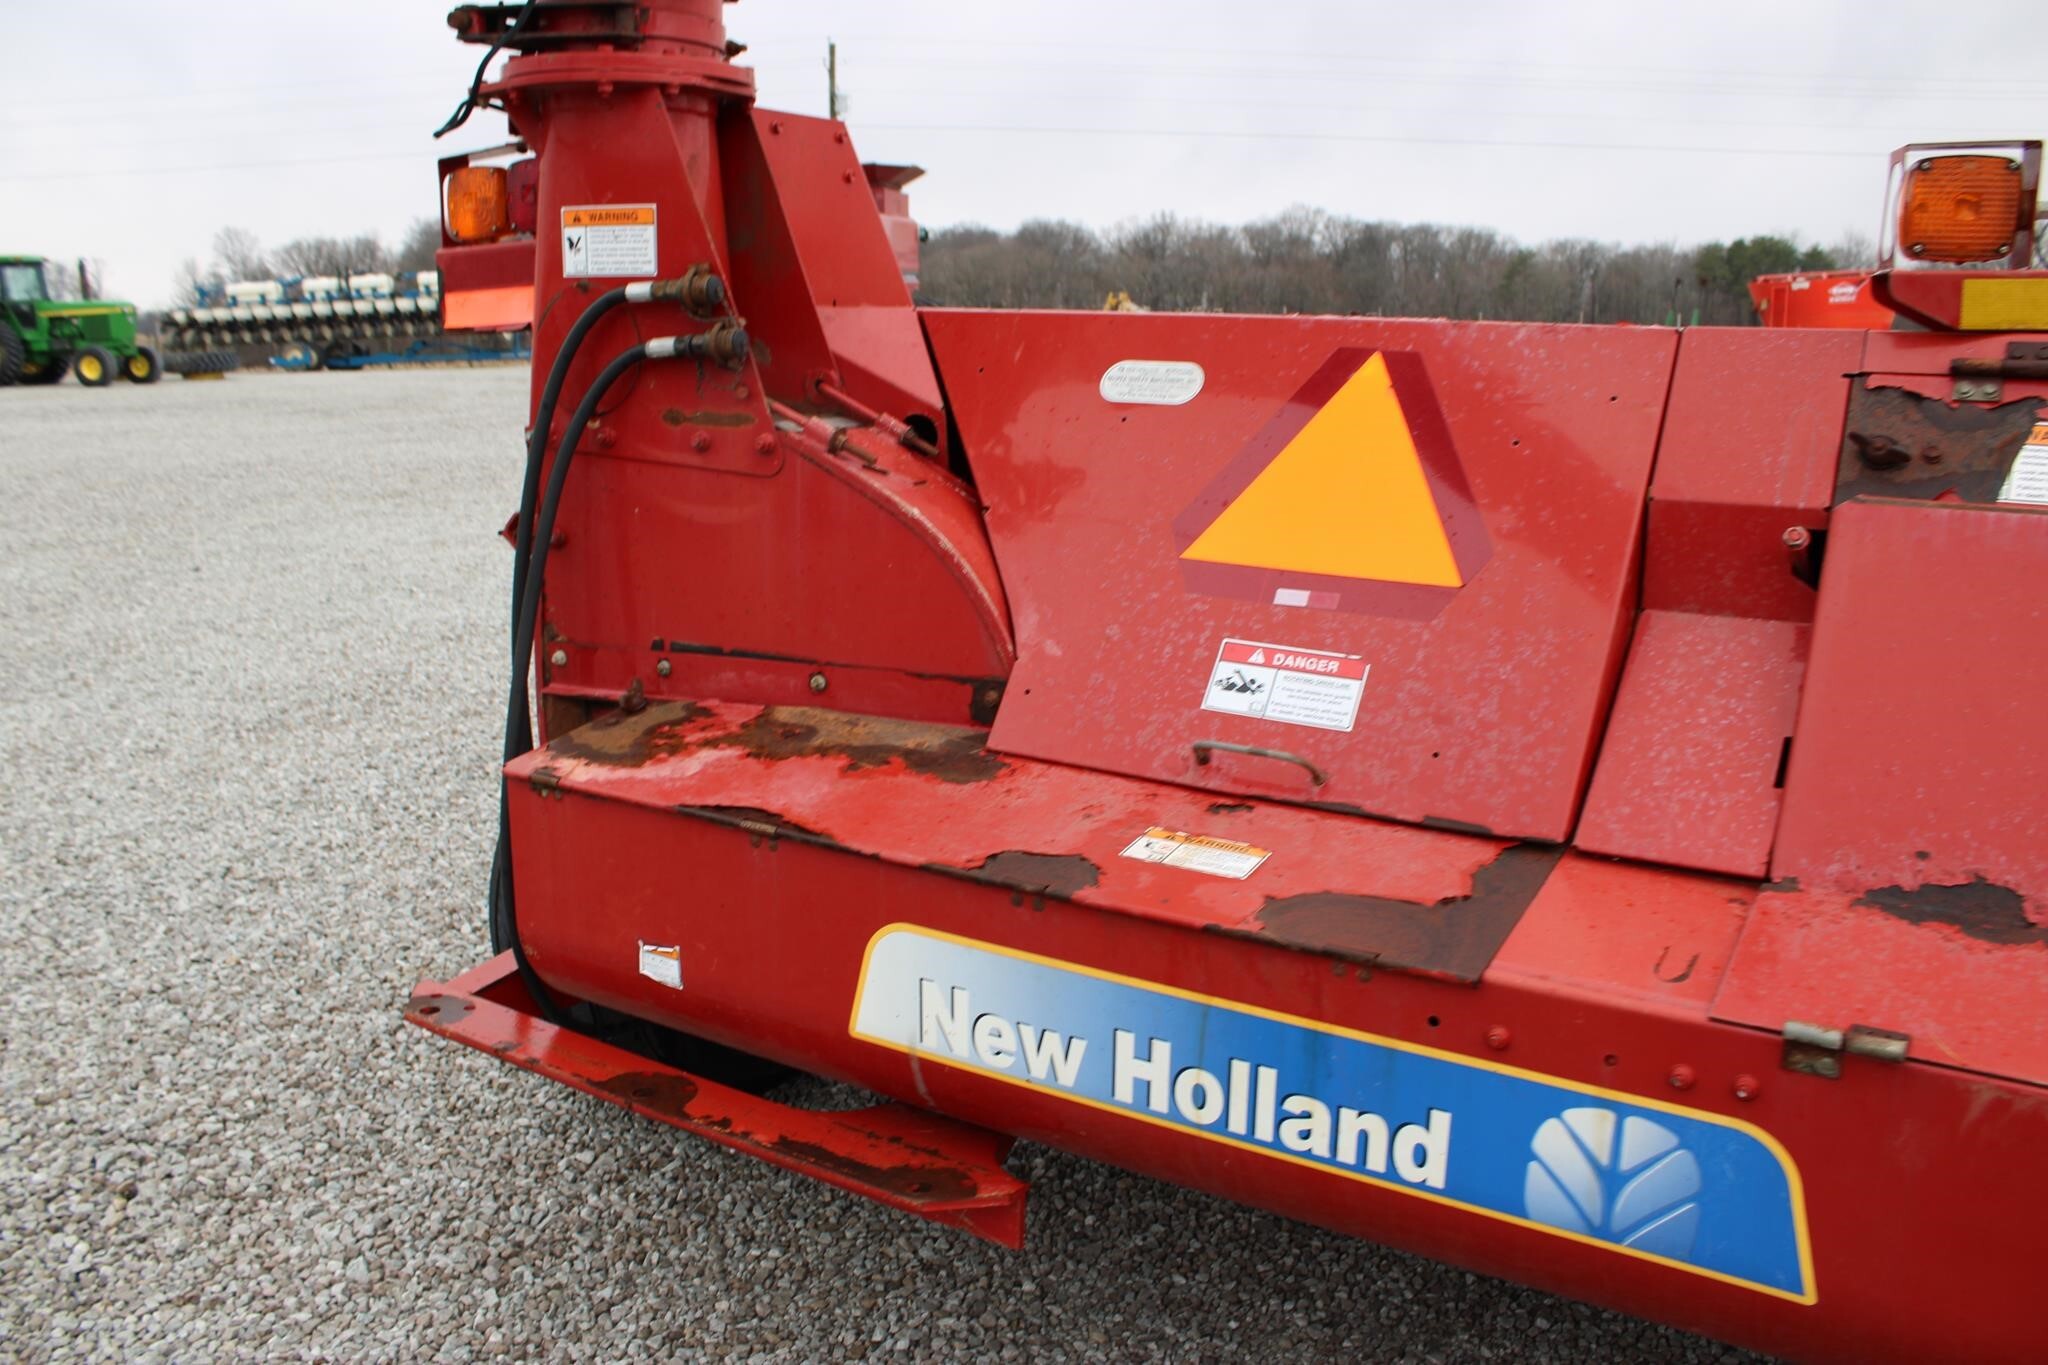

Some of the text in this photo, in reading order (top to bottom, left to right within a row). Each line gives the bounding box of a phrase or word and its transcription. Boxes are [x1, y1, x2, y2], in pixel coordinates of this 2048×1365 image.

[590, 211, 638, 221] WARNING
[1273, 653, 1340, 673] DANGER
[919, 976, 1453, 1190] New Holland
